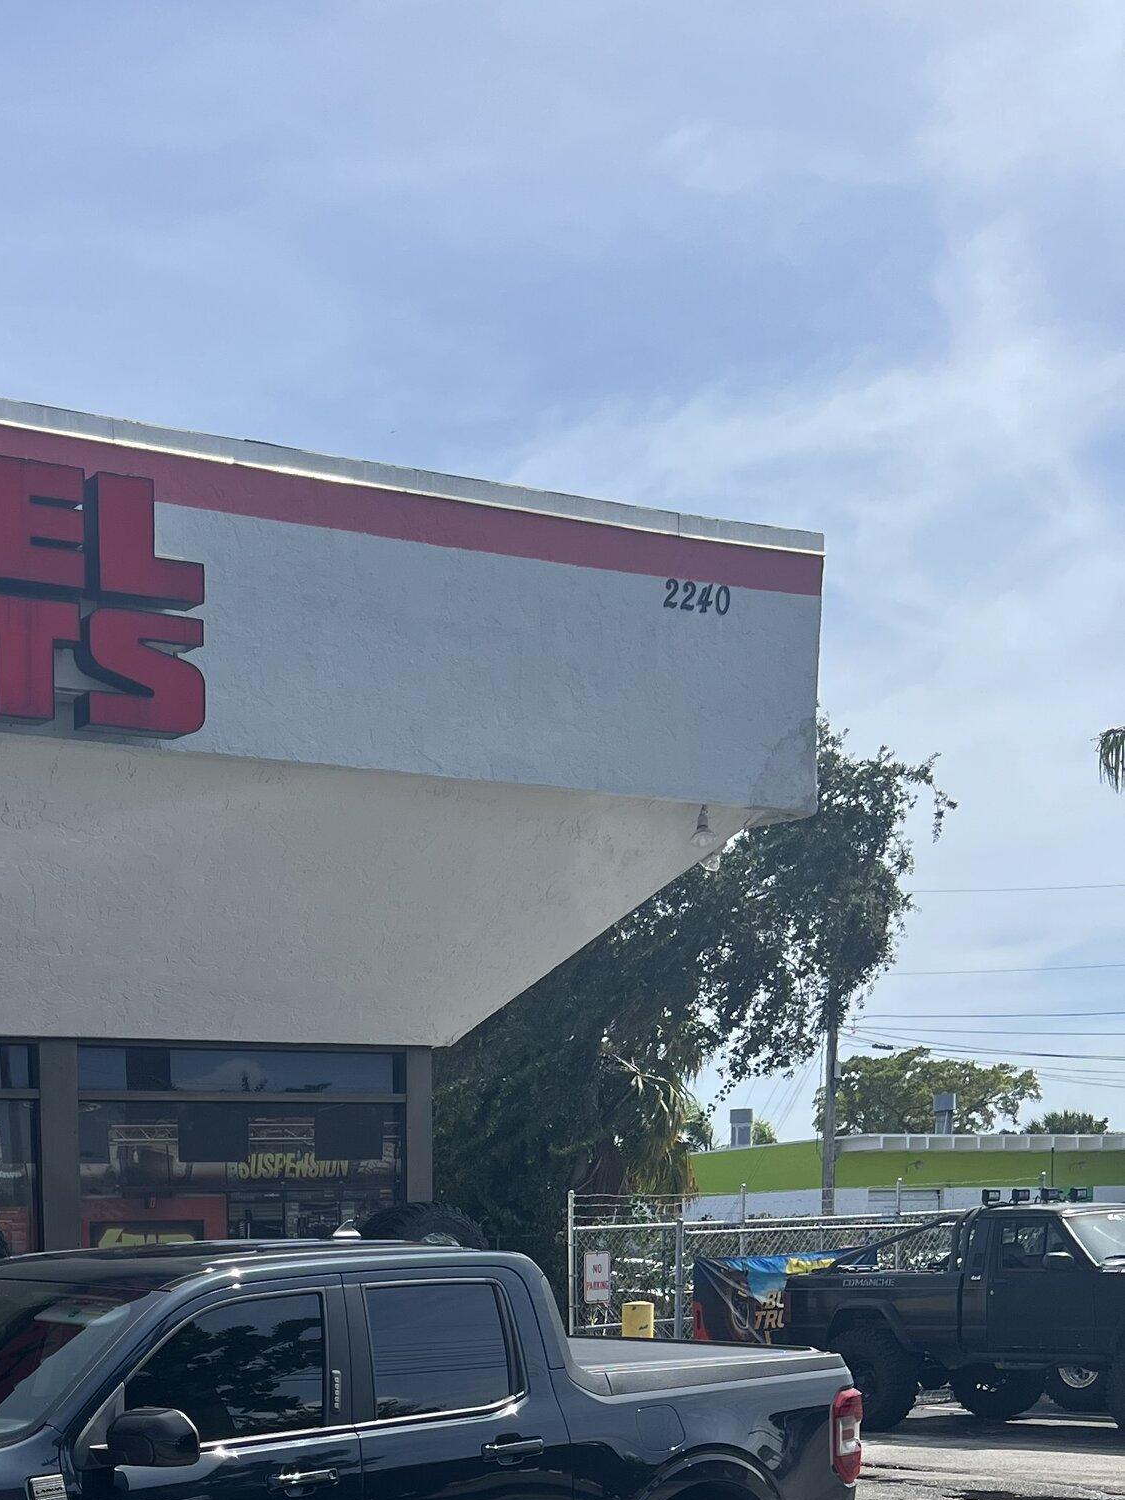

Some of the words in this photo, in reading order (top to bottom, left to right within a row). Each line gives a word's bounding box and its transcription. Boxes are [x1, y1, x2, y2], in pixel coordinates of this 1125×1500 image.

[663, 578, 730, 615] 2240
[592, 1263, 602, 1274] NO
[842, 1277, 896, 1287] COMANCHE
